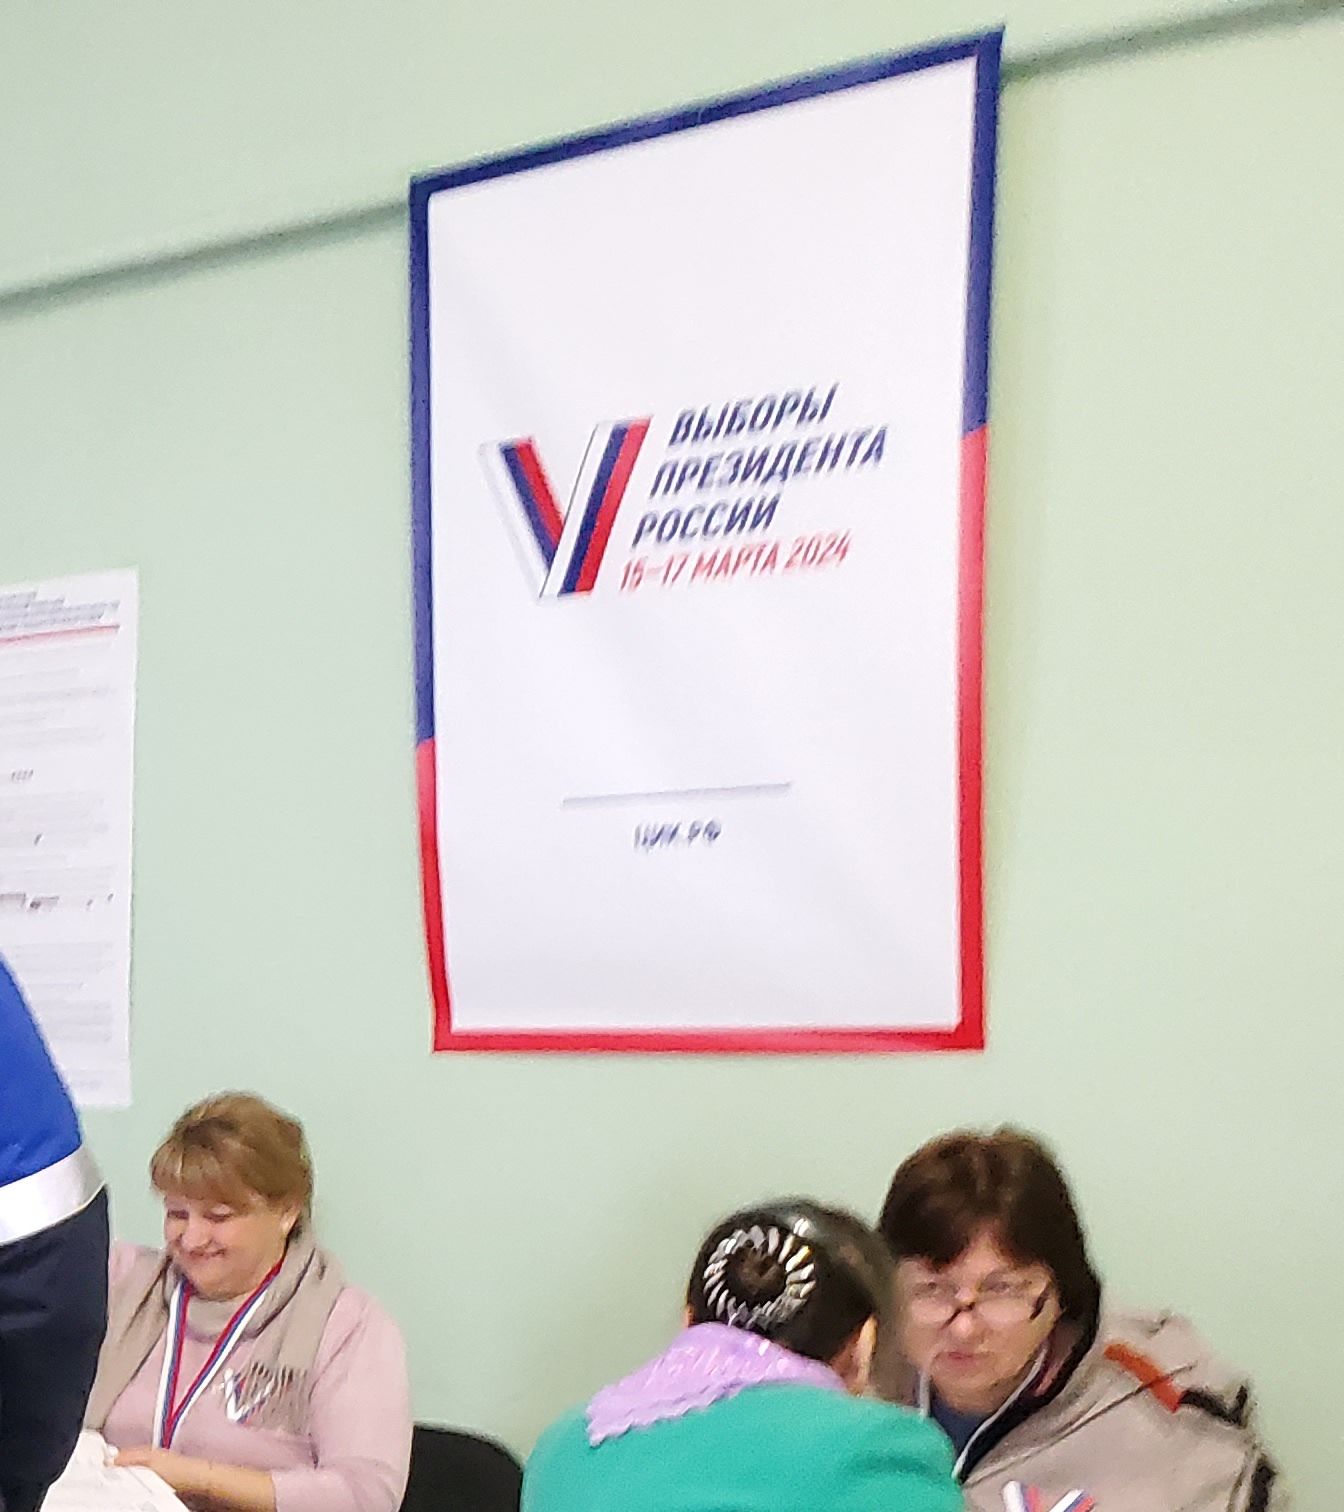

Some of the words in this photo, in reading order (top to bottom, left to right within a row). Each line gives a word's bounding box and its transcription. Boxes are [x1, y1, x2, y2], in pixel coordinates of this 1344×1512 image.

[669, 382, 839, 447] ВЫБОРЫ
[649, 423, 889, 499] ПРЕЗИДЕНТА
[632, 493, 781, 549] РОССИИ
[691, 541, 781, 583] МАРТА
[784, 529, 852, 575] 2024
